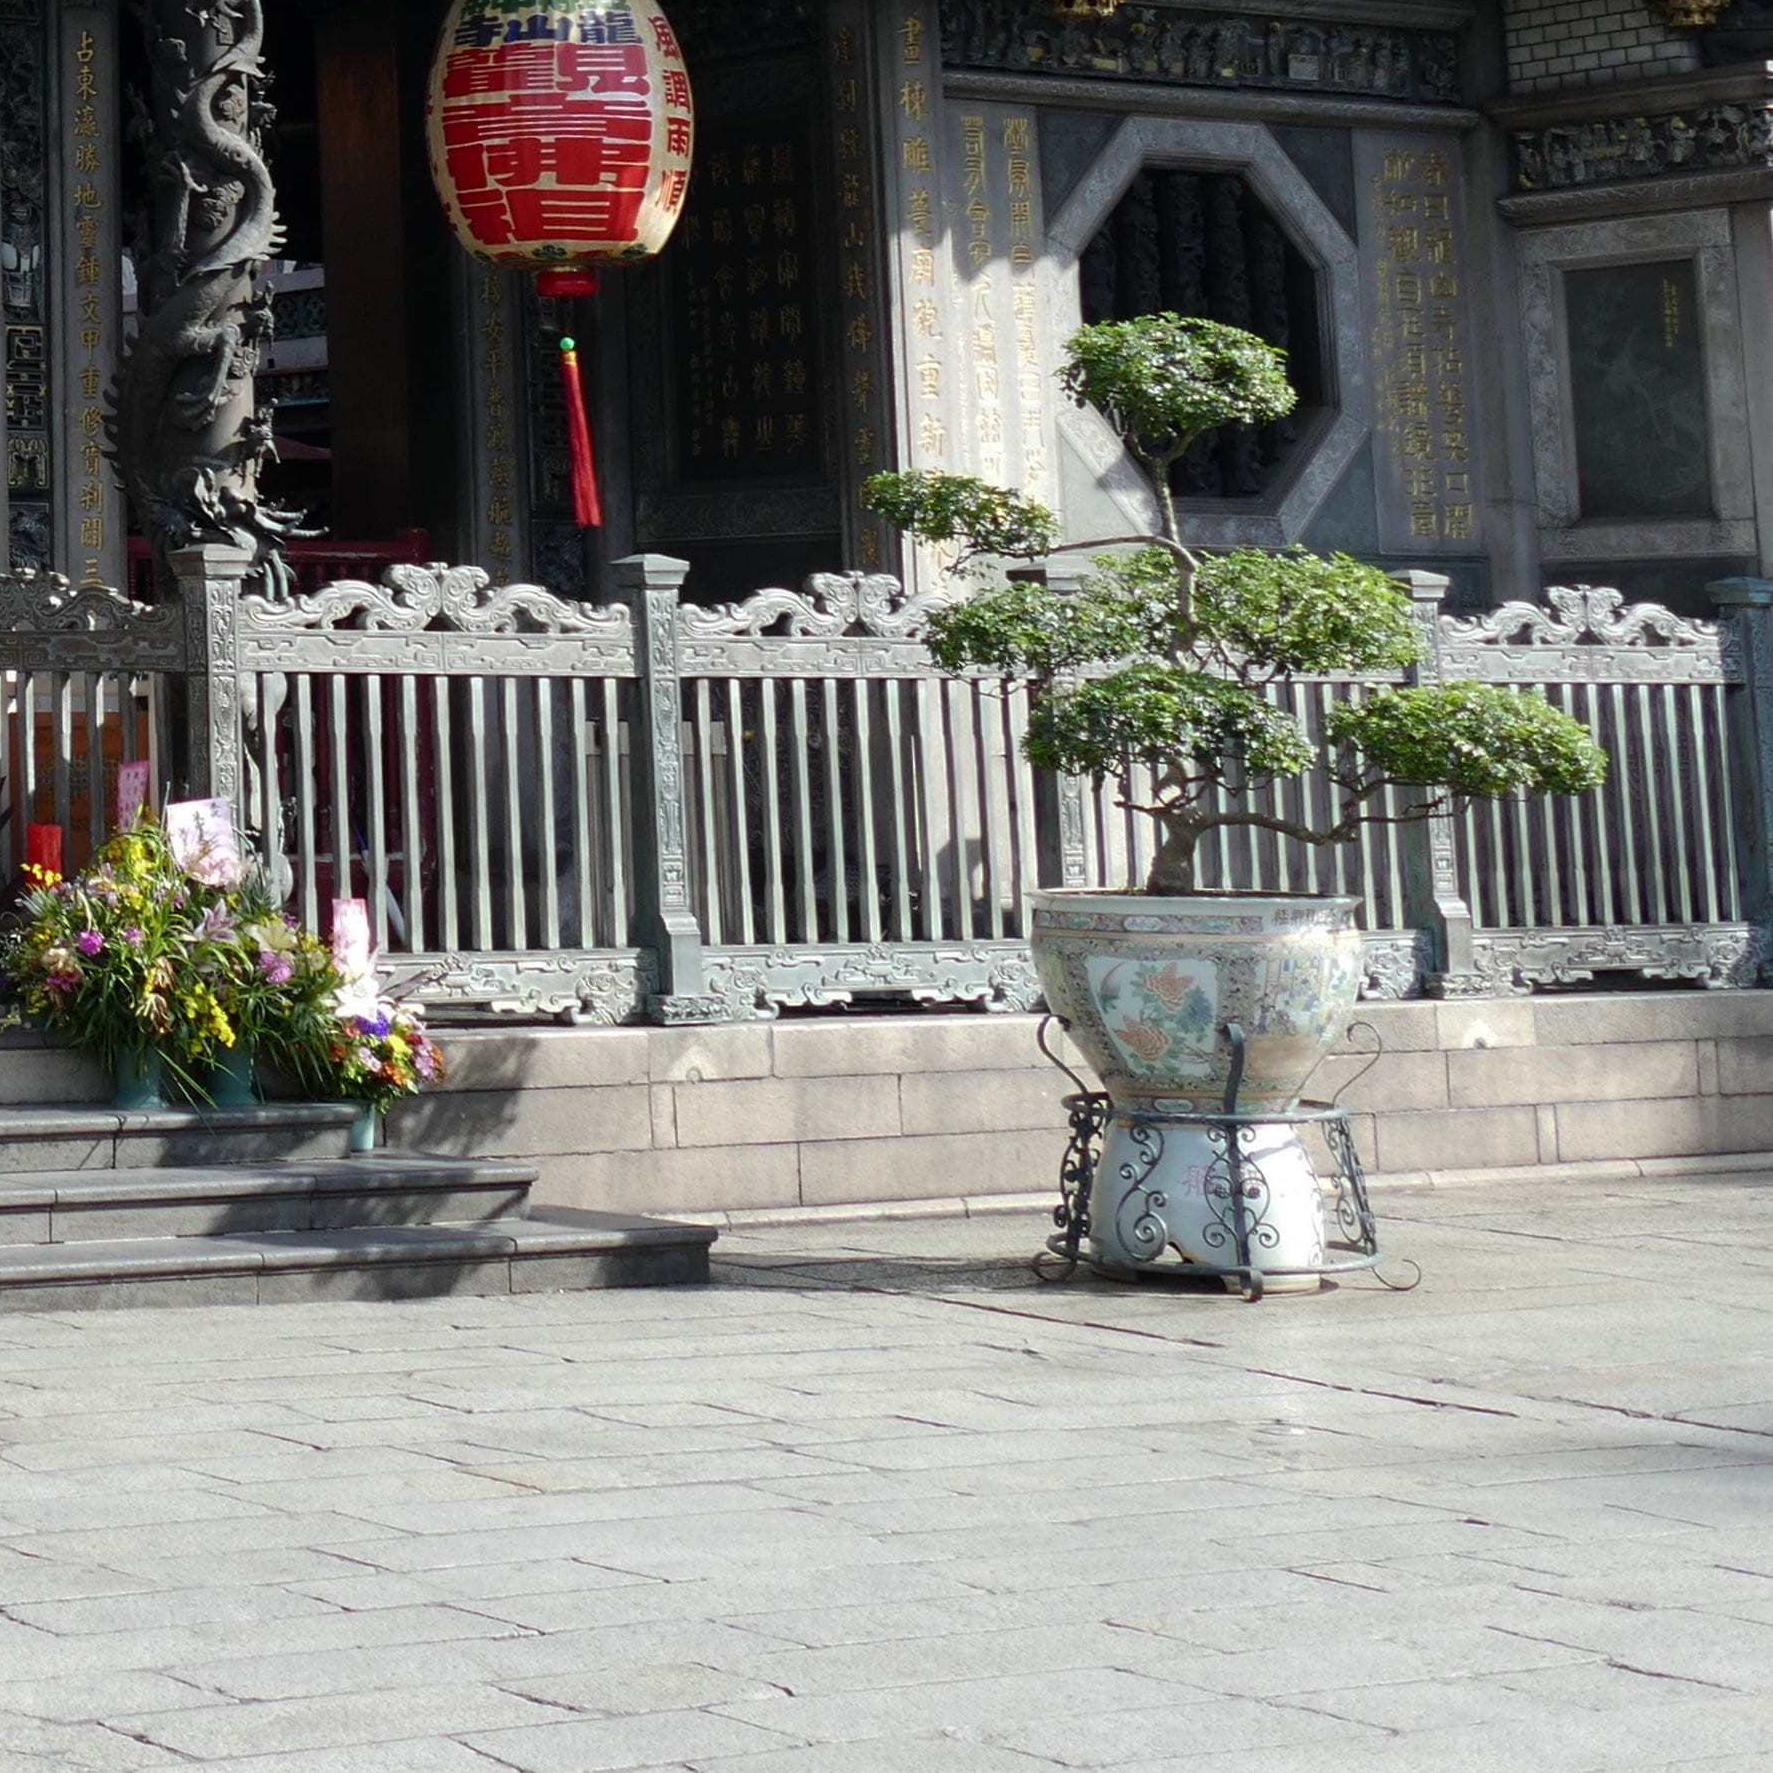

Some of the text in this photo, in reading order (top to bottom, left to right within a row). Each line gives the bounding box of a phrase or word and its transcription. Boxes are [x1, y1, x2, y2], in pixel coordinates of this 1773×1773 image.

[455, 12, 644, 47] 龍山寺
[648, 15, 692, 214] 風調雨順
